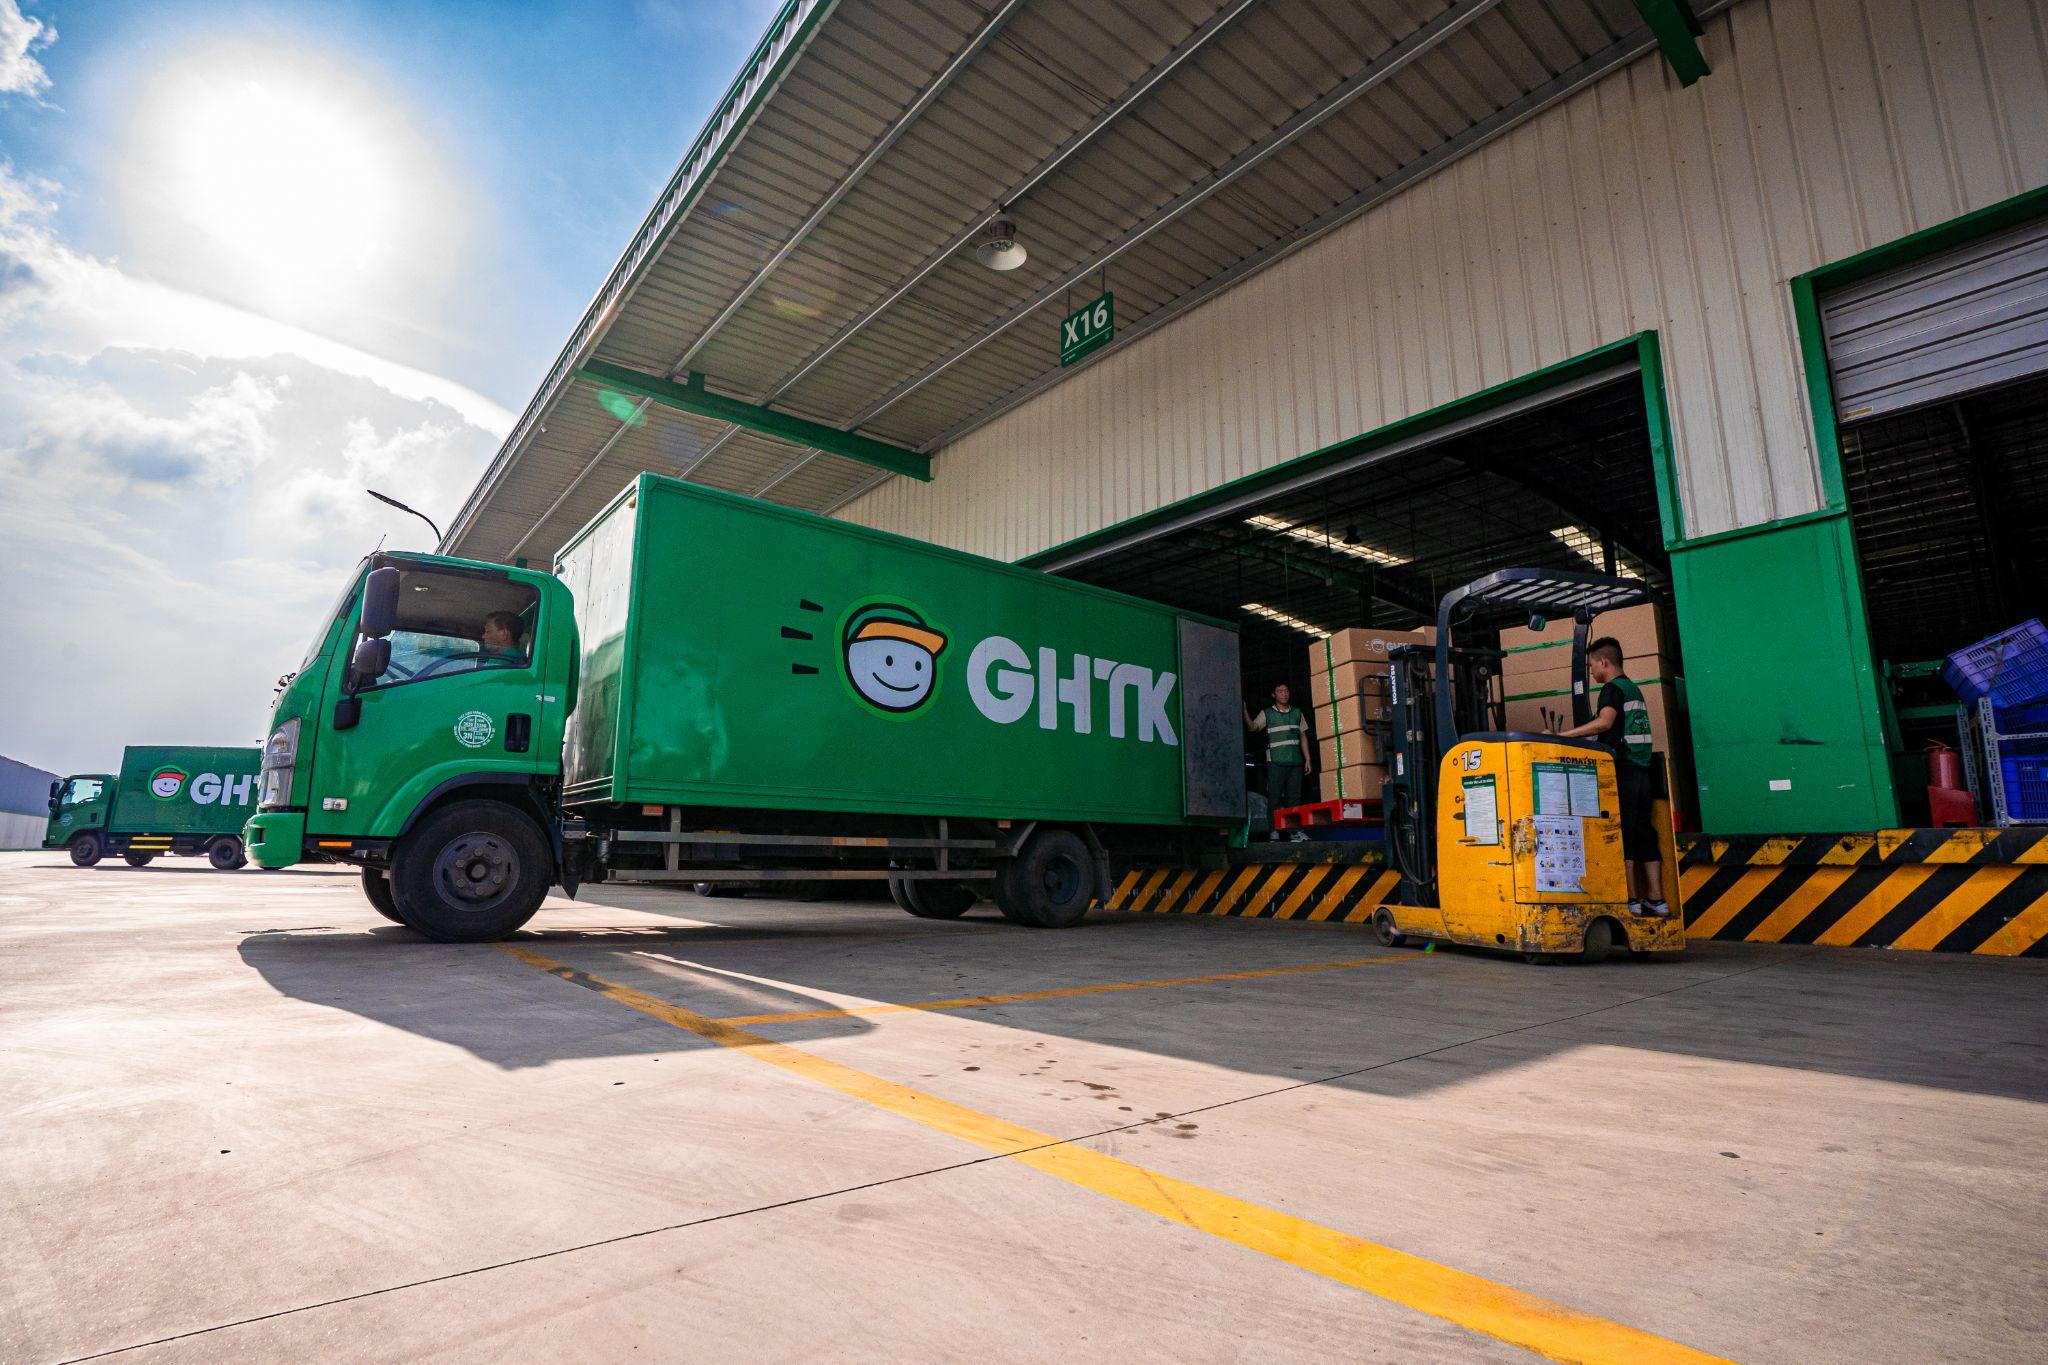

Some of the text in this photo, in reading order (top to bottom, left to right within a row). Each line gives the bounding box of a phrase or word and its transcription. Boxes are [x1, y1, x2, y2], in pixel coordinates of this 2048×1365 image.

[1064, 300, 1108, 349] X16
[966, 635, 1179, 746] GHTK
[1390, 665, 1398, 705] KOMATSU
[1461, 749, 1482, 771] 15
[1560, 756, 1597, 766] KOMATSU
[190, 772, 261, 806] GH
